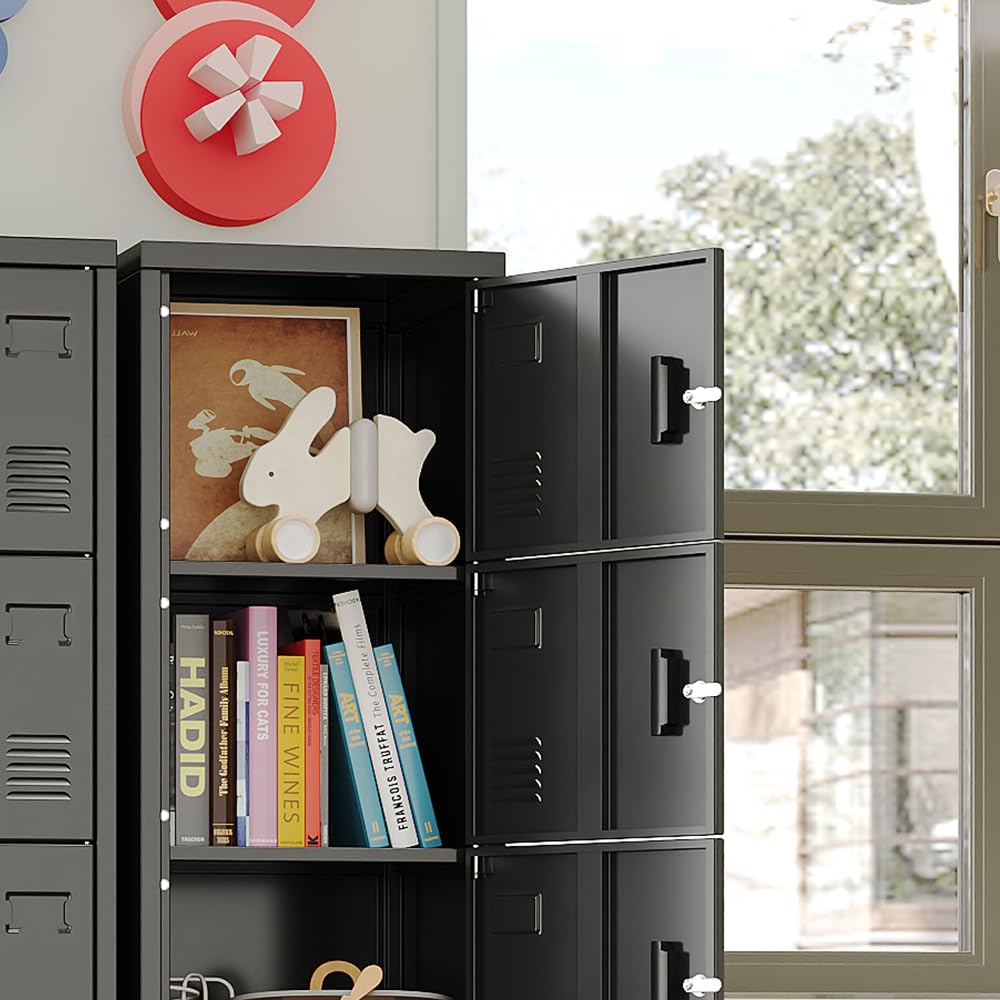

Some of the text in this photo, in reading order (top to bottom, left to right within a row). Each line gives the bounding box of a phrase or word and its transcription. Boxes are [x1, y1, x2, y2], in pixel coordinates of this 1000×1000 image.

[355, 624, 366, 648] Films
[256, 631, 269, 741] LUXURY FOR CATS
[362, 653, 376, 697] Complete
[180, 657, 206, 797] HADID
[219, 666, 230, 796] The Godfather Family Album
[283, 682, 300, 734] FINE
[340, 693, 360, 723] ART
[372, 700, 382, 718] The
[389, 693, 409, 724] ART
[374, 724, 394, 772] TRUFFAT
[283, 746, 300, 823] WINES
[307, 835, 319, 845] K
